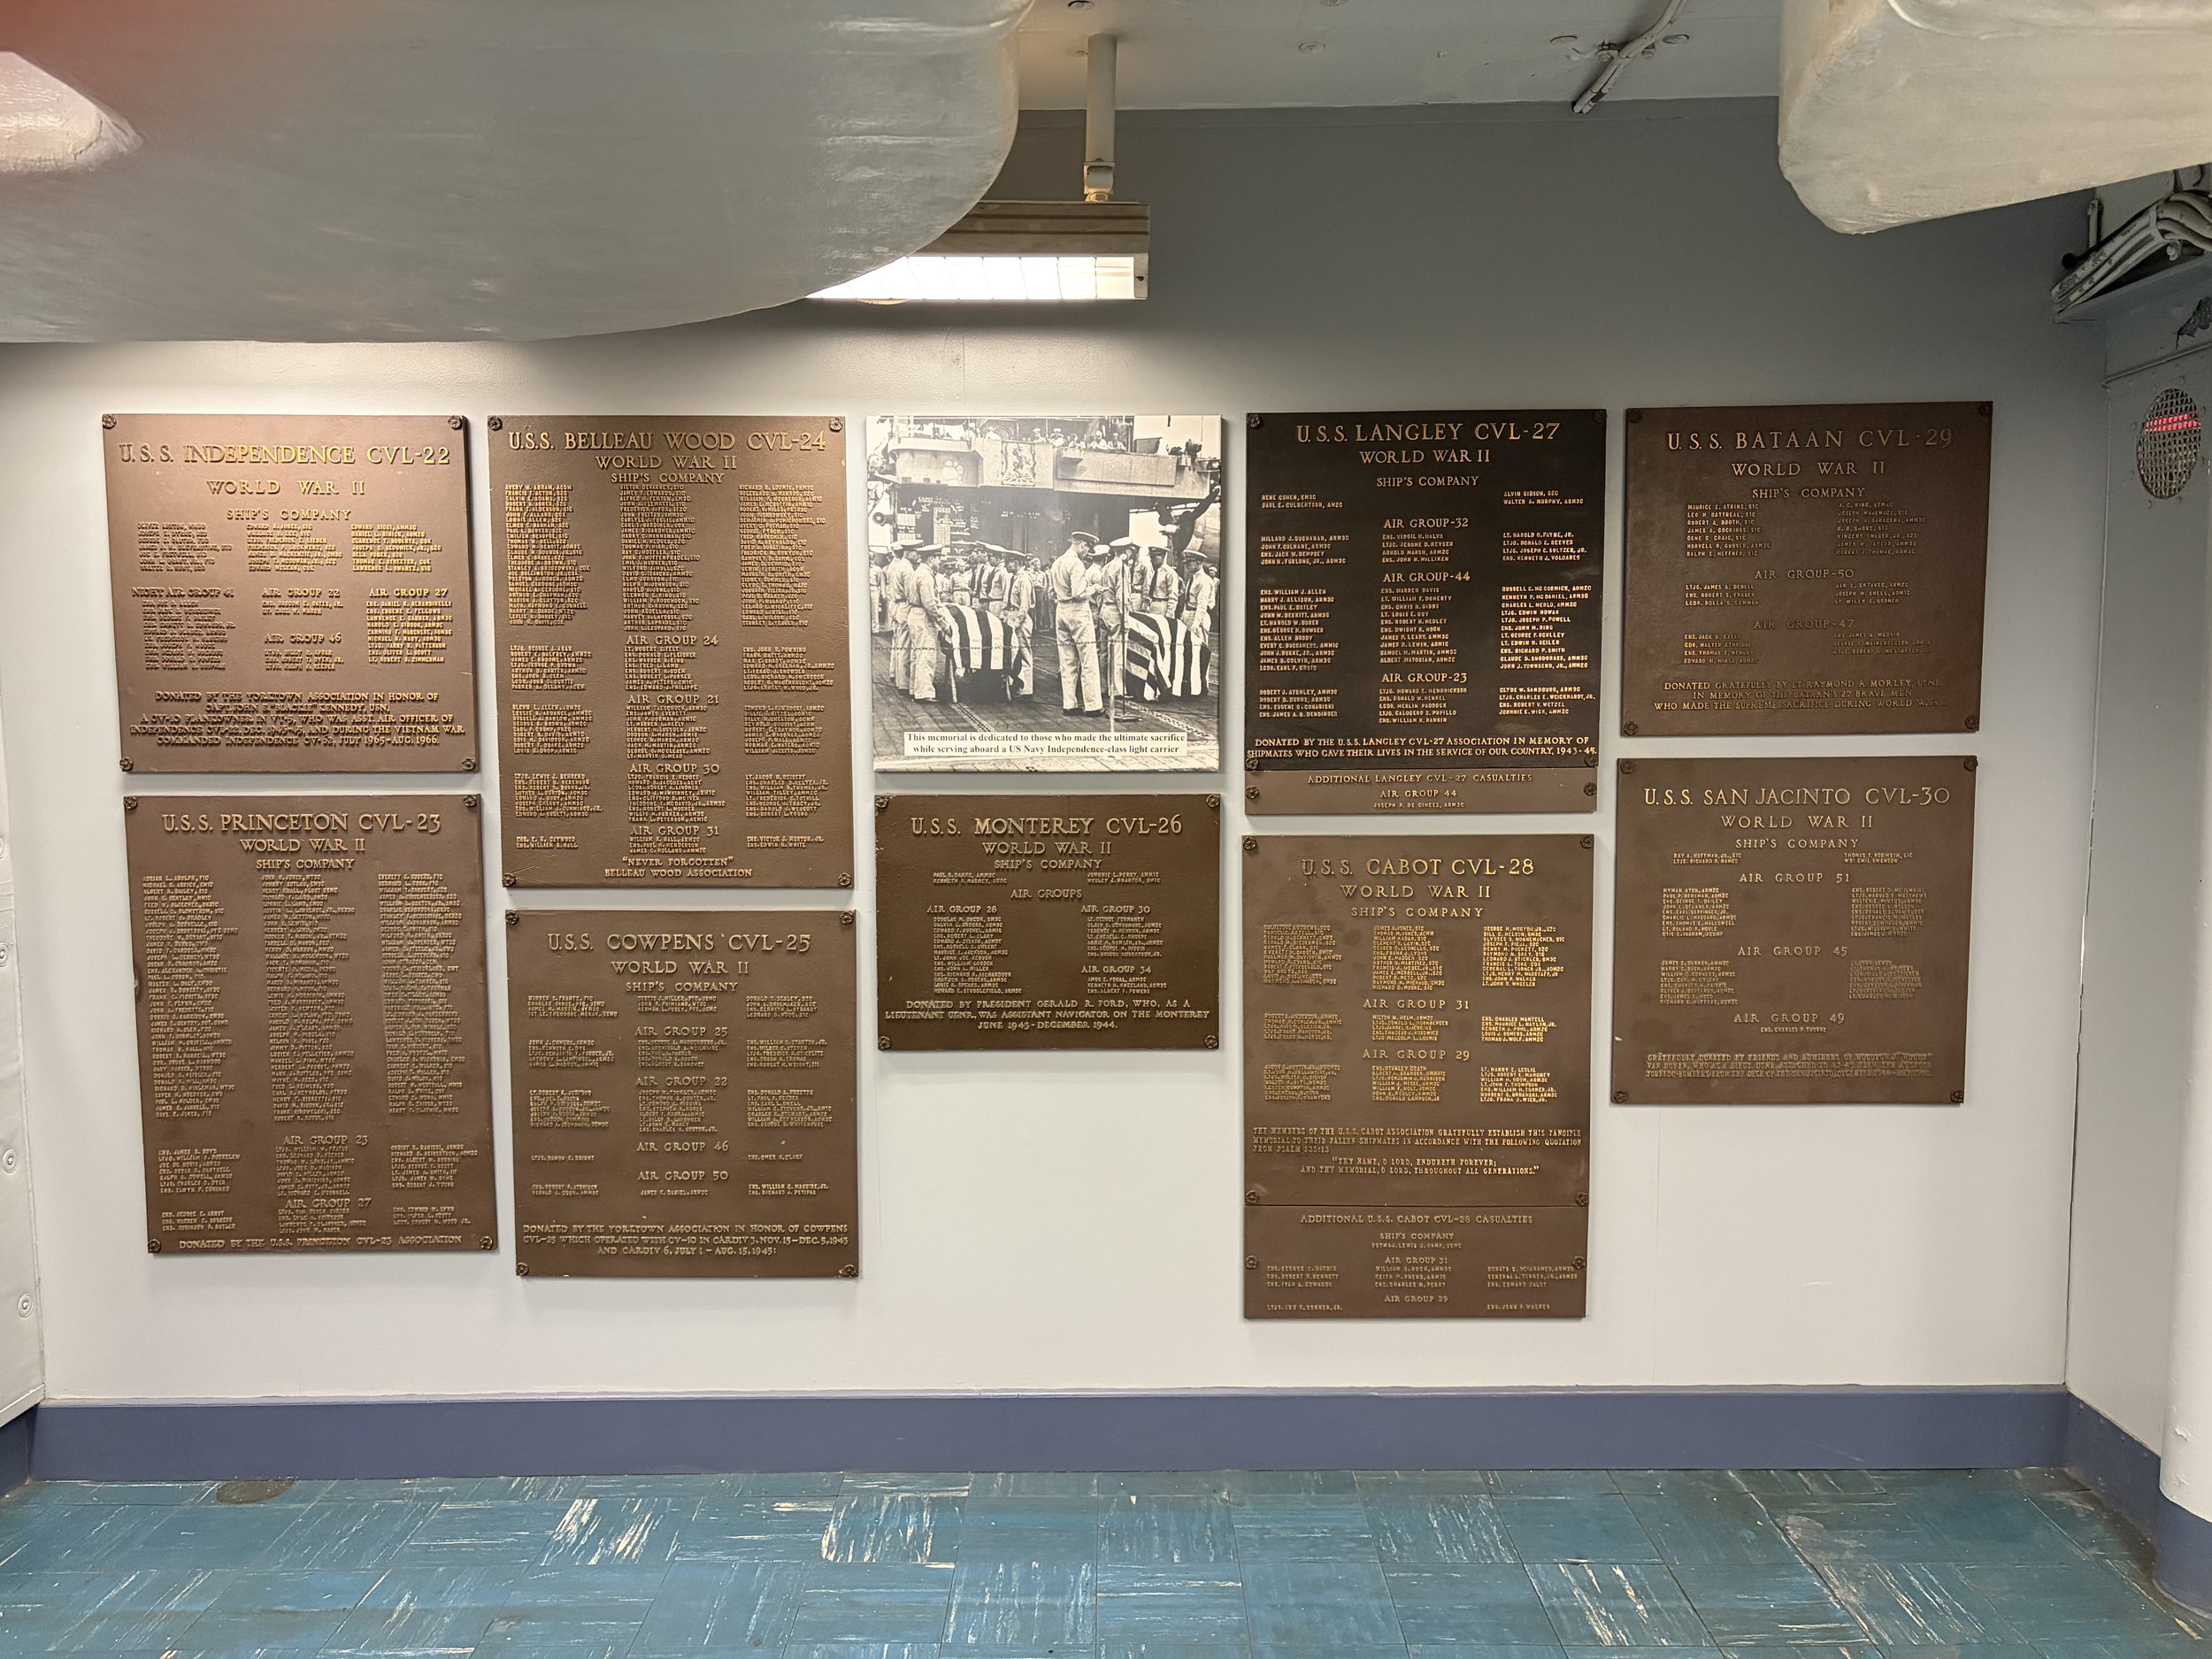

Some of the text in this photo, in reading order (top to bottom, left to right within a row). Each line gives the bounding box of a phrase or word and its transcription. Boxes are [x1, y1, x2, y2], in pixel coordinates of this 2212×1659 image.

[1296, 422, 1561, 442] U.S.S. LANGLEY CVL-27
[509, 432, 826, 451] U.S.S. BELLEAU WOOD CVL-24
[1668, 428, 1954, 450] U.S.S. BATAAN CVL-29
[119, 443, 450, 465] U.S.S. INDEPENDENCE CVL-22
[1360, 449, 1491, 465] WORLD WAR II
[595, 456, 737, 470] WORLD WAR II
[1731, 462, 1886, 476] WORLD WAR II
[611, 472, 725, 484] SHIP'S COMPANY
[1377, 476, 1479, 488] SHIP'S COMPANY
[207, 480, 365, 495] WORLD WAR II
[1752, 488, 1866, 499] SHIP'S COMPANY
[227, 508, 351, 520] SHIP'S COMPANY
[1383, 518, 1470, 528] AIR GROUP-32
[1383, 571, 1470, 582] AIR GROUP-44
[1755, 569, 1855, 580] AIR GROUP-50
[369, 588, 449, 597] AIR GROUP 27
[626, 636, 718, 646] AIR GROUP 24
[1381, 672, 1468, 683] AIR GROUP-23
[1255, 738, 1299, 747] DONATED
[1024, 745, 1044, 754] Navy
[1048, 745, 1126, 754] Independence-class
[1129, 745, 1148, 754] light
[1644, 787, 1950, 806] U.S.S. SAN JACINTO CVL-30
[162, 813, 442, 833] U.S.S. PRINCETON CVL-23
[911, 814, 1182, 835] U.S.S. MONTEREY CVL-26
[1721, 815, 1873, 828] WORLD WAR II
[241, 839, 365, 852] WORLD WAR II
[982, 841, 1111, 856] WORLD WAR II
[1735, 839, 1859, 849] SHIP'S COMPANY
[256, 859, 356, 870] SHIP'S COMPANY
[622, 856, 733, 866] "NEVER FORGOTTEN"
[994, 859, 1102, 870] SHIP'S COMPANY
[1302, 858, 1534, 876] U.S.S. CABOT CVL-28
[1740, 872, 1851, 883] AIR GROUP 51
[1010, 889, 1082, 899] AIR GROUPS
[1340, 886, 1490, 898] WORLD WAR II
[1351, 907, 1484, 918] SHIP'S COMPANY
[548, 934, 811, 952] U.S.S. COWPENS CVL-25
[611, 961, 749, 975] WORLD WAR II
[626, 981, 739, 992] SHIP'S COMPANY
[1363, 1000, 1470, 1010] AIR GROUP 31
[634, 1026, 728, 1036] AIR GROUP 25
[1301, 1215, 1364, 1224] ADDITIONAL
